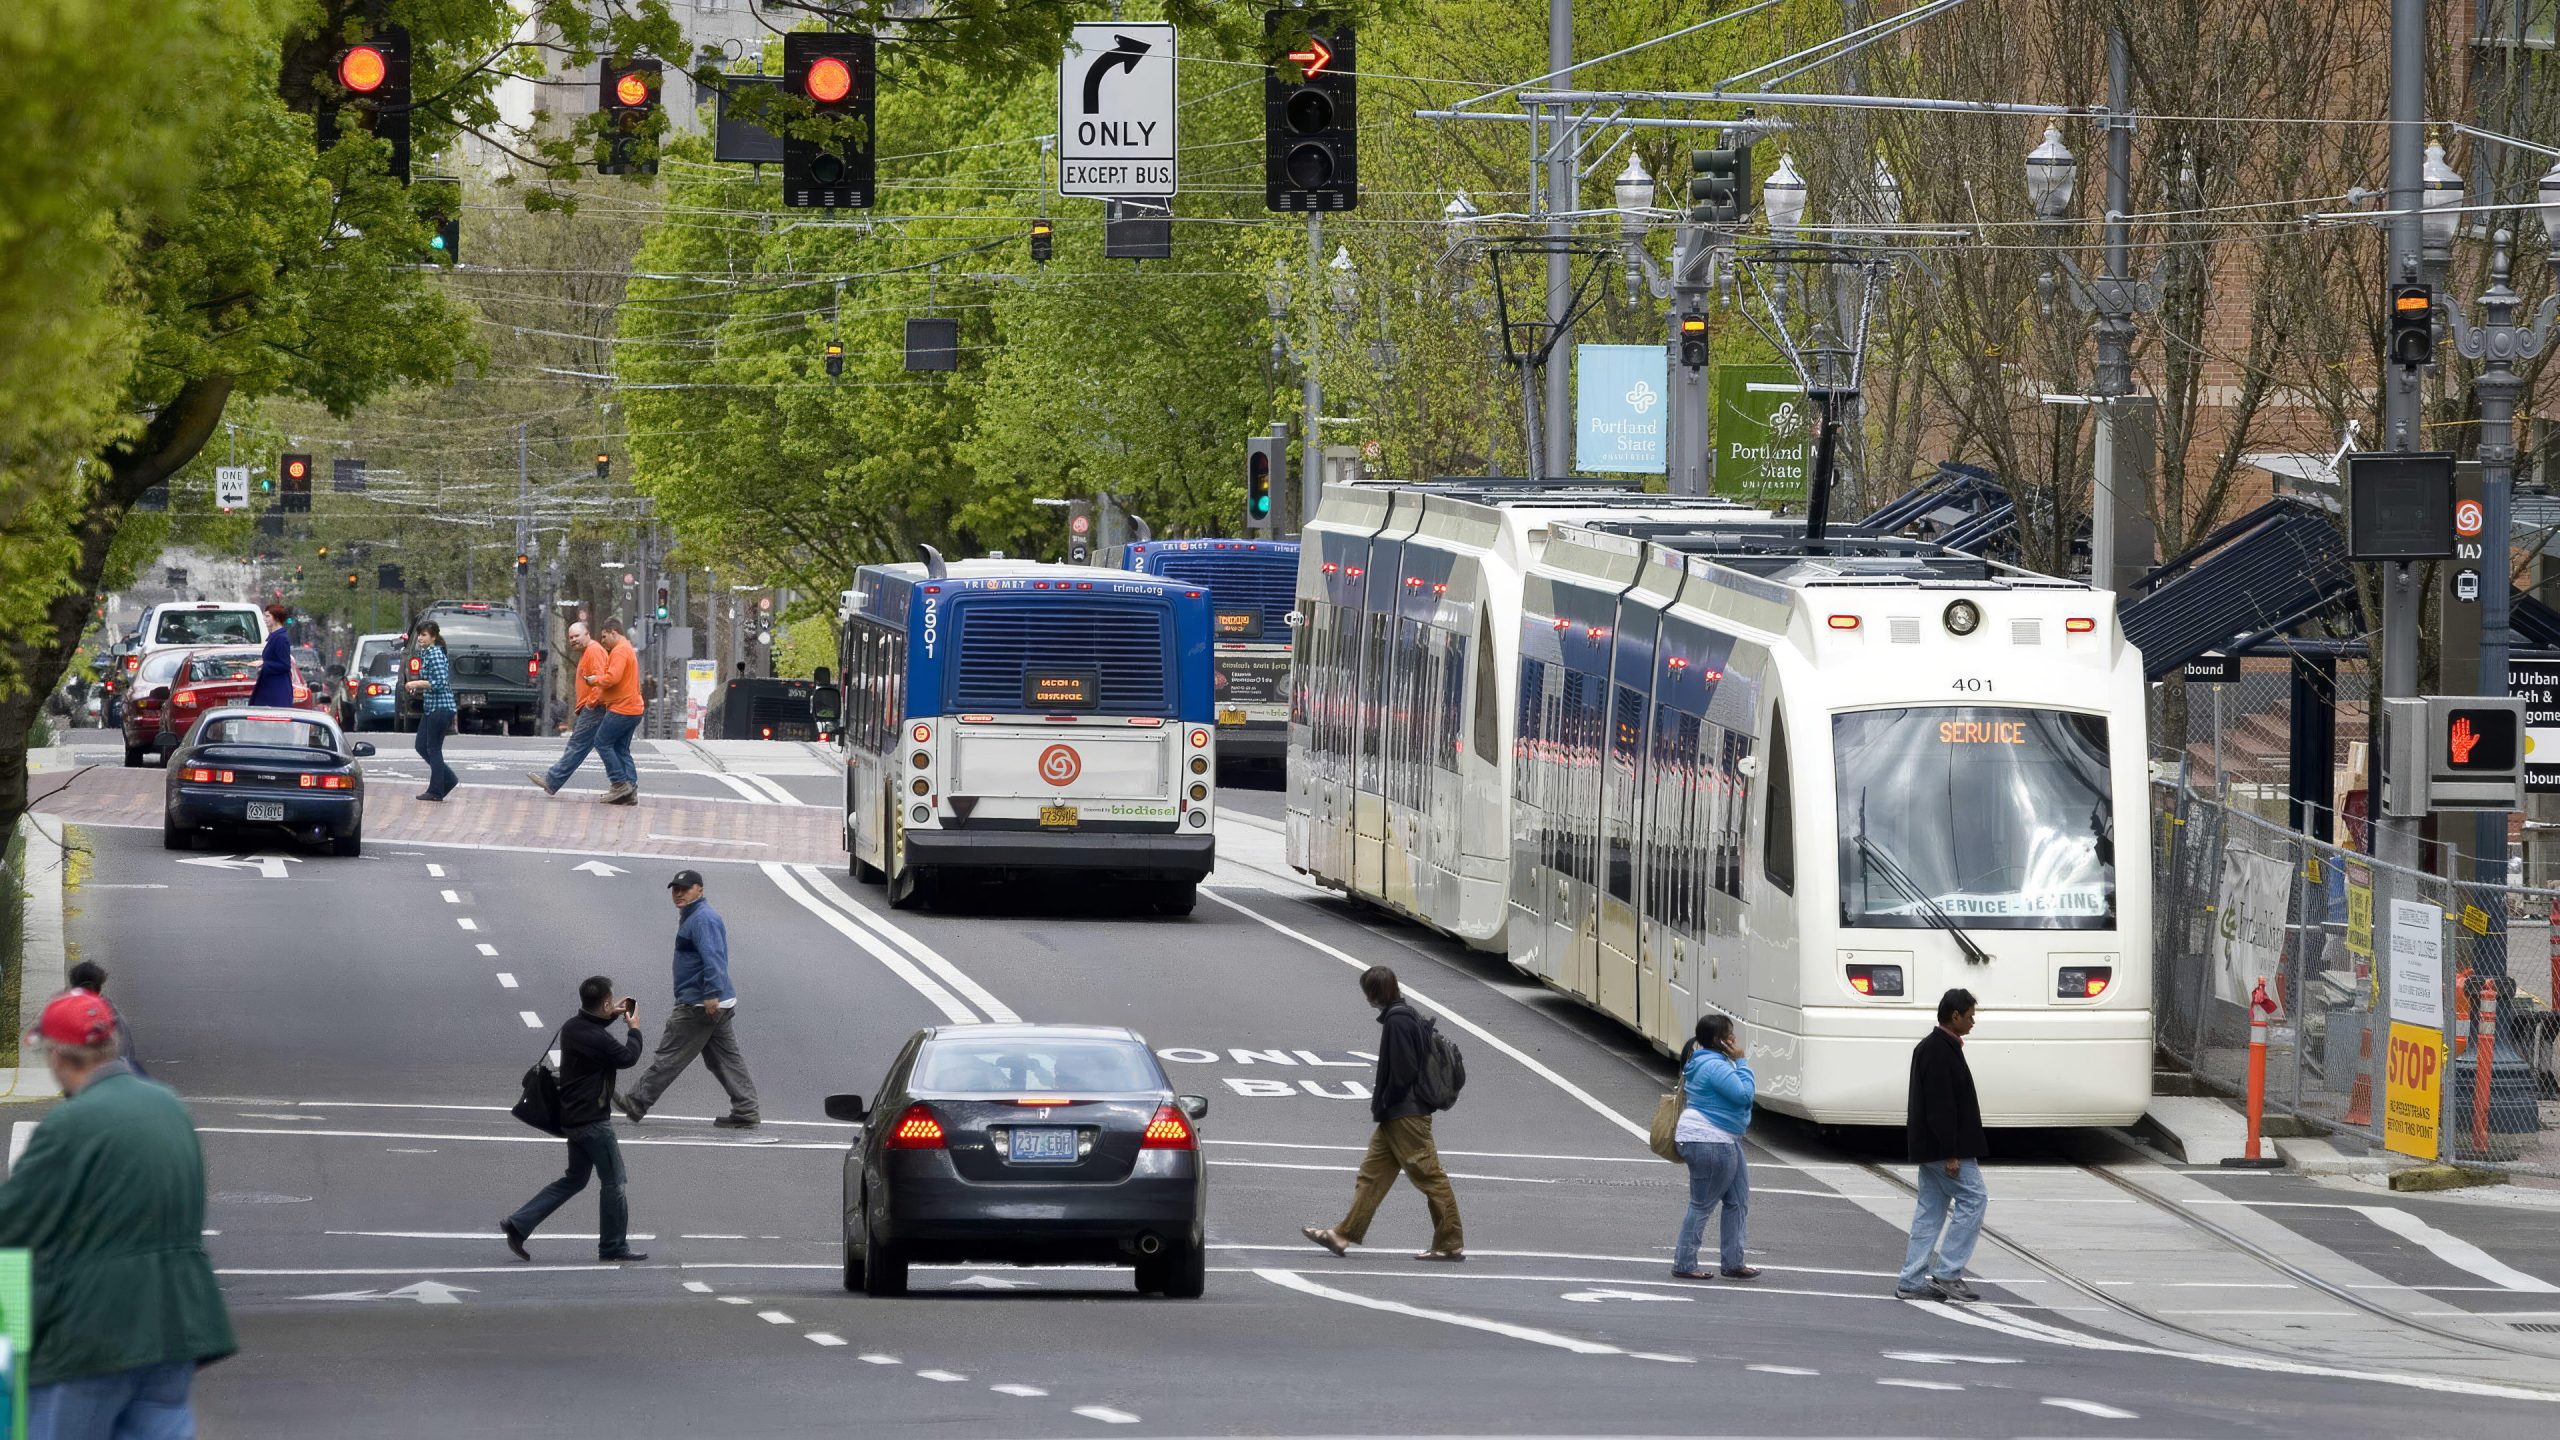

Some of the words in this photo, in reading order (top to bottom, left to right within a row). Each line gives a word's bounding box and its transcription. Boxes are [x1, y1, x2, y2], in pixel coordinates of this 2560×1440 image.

[1078, 121, 1157, 147] ONLY
[1066, 166, 1128, 184] EXCEPT
[1136, 166, 1169, 184] BUS
[1591, 417, 1656, 434] Portland
[1617, 435, 1656, 451] State
[222, 470, 243, 481] ONE
[222, 481, 244, 491] WAY
[964, 580, 984, 589] TRI
[924, 598, 937, 659] 2901
[2184, 662, 2224, 675] bound
[1952, 678, 1993, 692] 401
[2519, 671, 2559, 685] Urban
[2542, 690, 2553, 703] &
[1939, 721, 2026, 744] SERVICE
[1936, 899, 2008, 914] SERVICE
[2025, 893, 2099, 912] TETING
[2389, 1036, 2436, 1091] STOP
[1222, 1078, 1374, 1100] BU
[1017, 1134, 1040, 1152] 237
